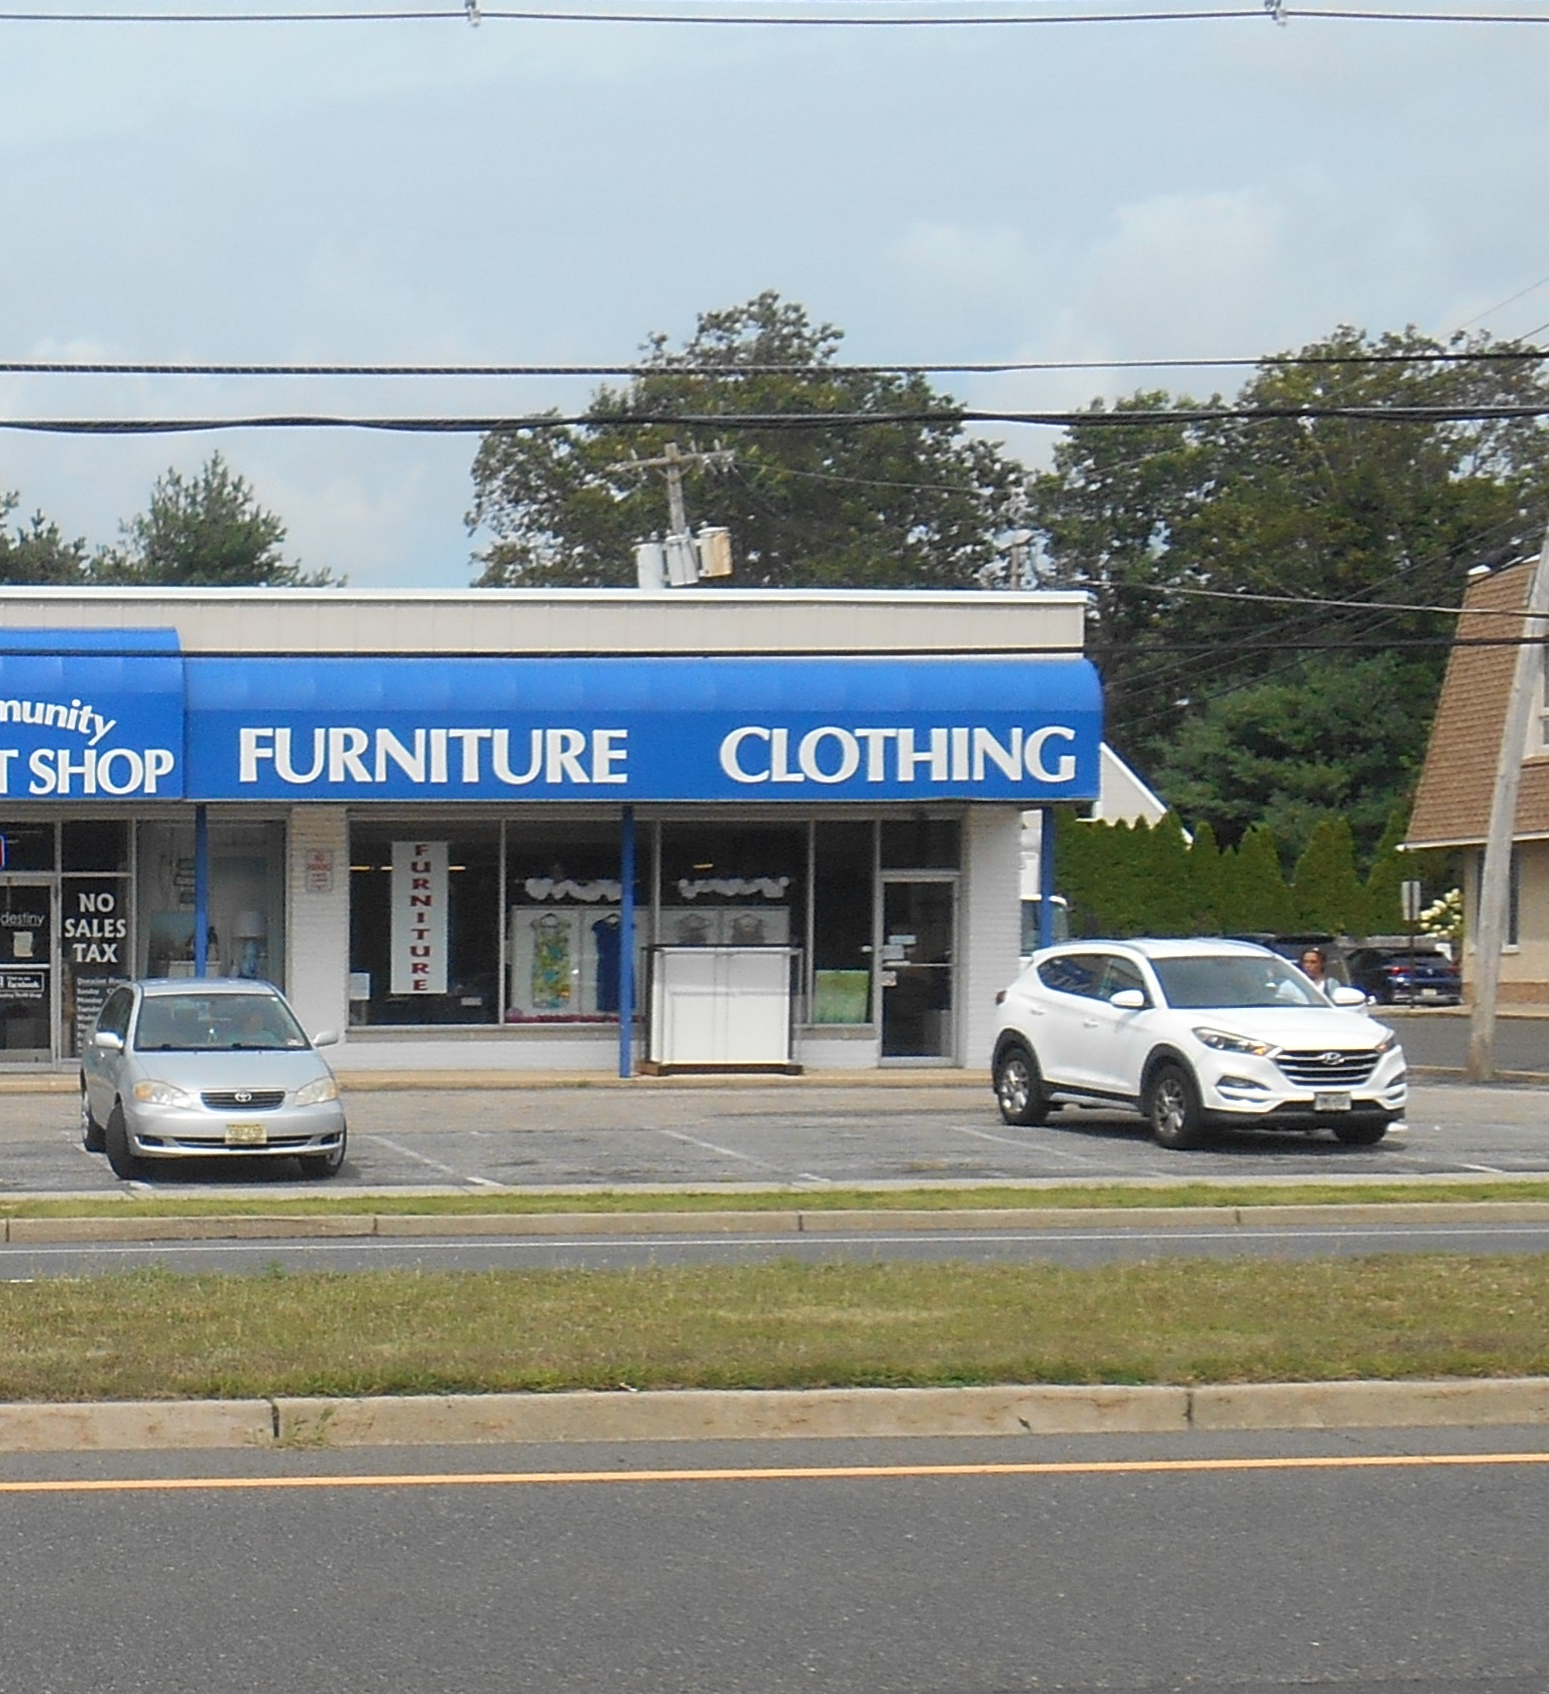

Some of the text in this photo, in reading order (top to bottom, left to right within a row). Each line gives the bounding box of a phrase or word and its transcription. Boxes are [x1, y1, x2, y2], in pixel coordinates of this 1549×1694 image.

[239, 725, 1077, 786] FURNITURE CLOTHING
[28, 747, 175, 795] SHOP
[78, 892, 115, 913] NO
[1, 911, 46, 926] destiny
[409, 843, 432, 992] FURNITURE
[64, 918, 127, 939] SALES
[72, 943, 119, 963] TAX
